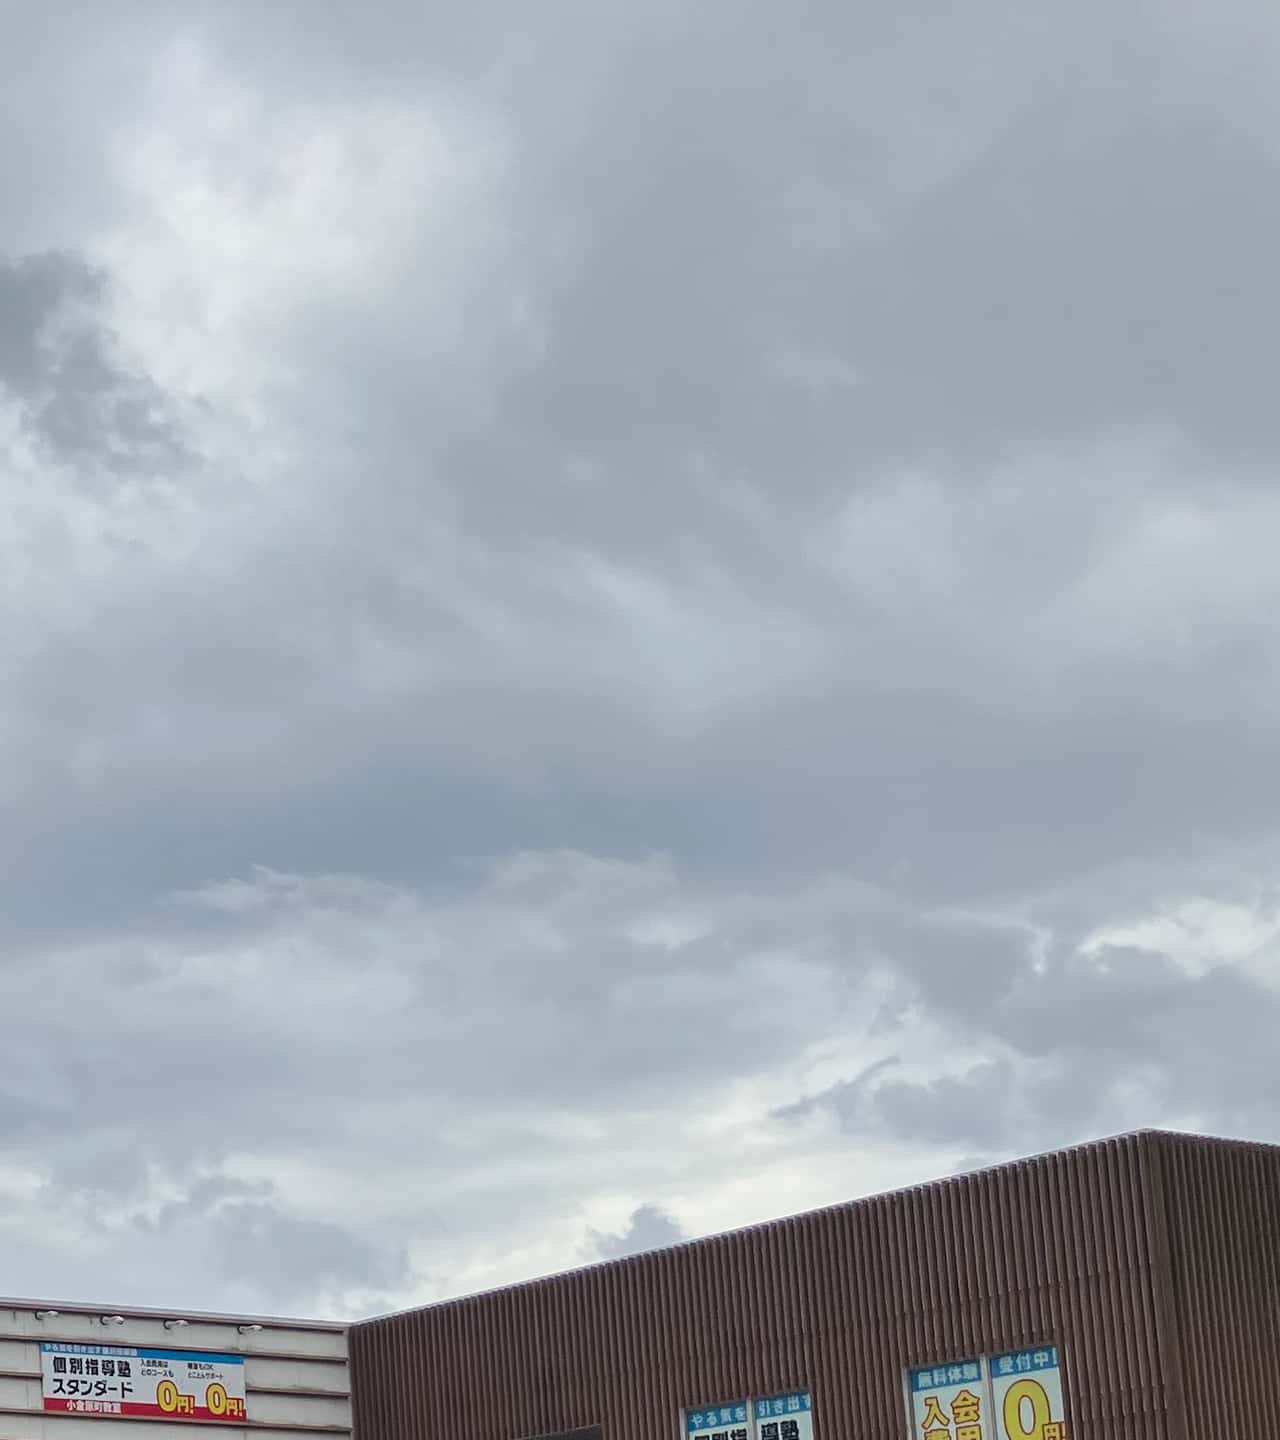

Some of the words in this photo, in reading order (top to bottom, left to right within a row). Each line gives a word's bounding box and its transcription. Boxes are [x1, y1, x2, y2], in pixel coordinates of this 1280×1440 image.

[53, 1356, 132, 1378] 個別指導塾
[53, 1378, 133, 1398] スタンダード
